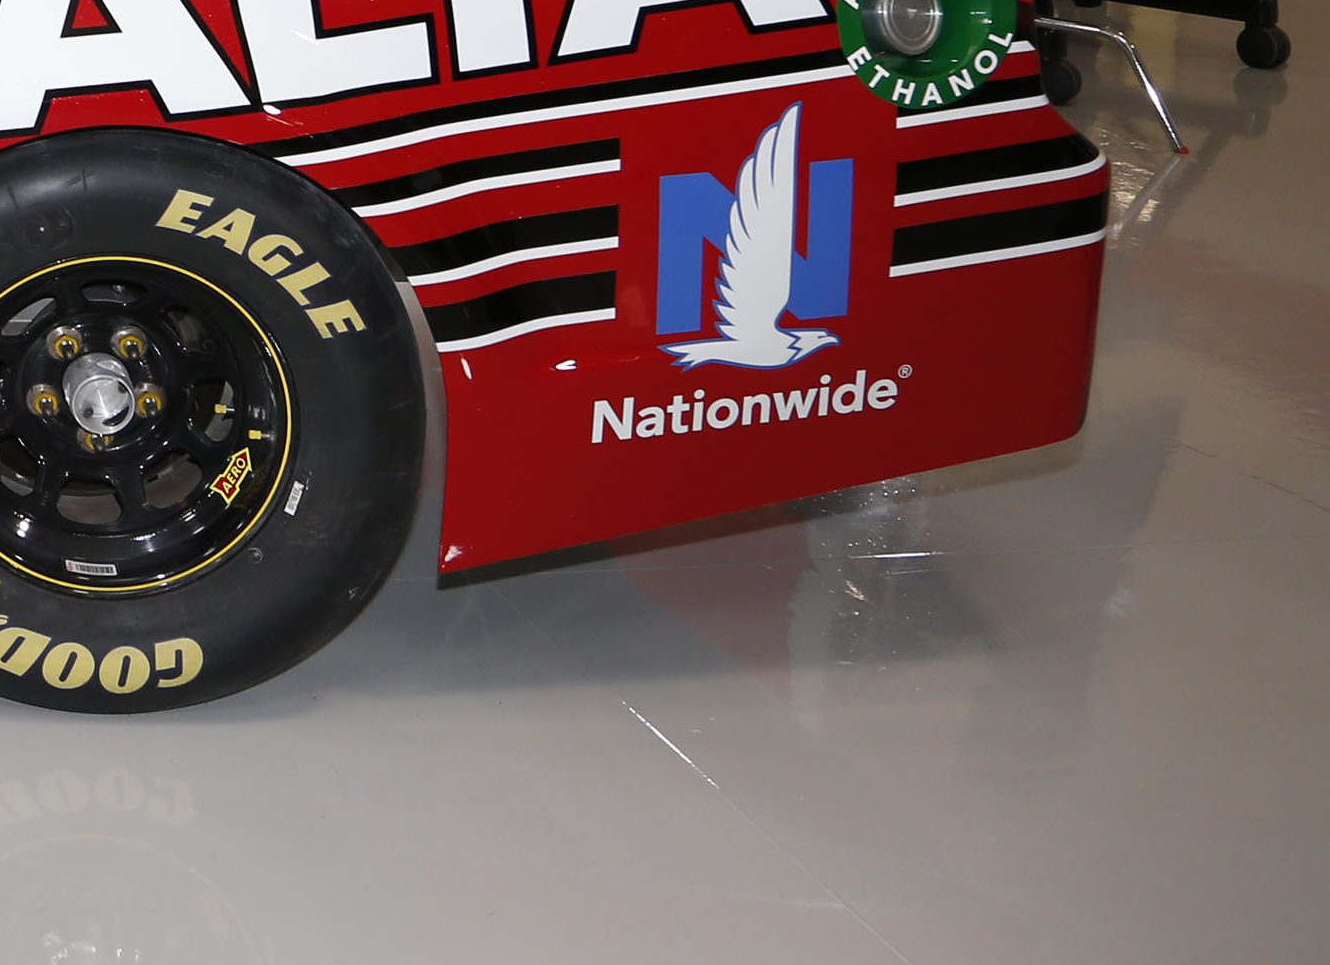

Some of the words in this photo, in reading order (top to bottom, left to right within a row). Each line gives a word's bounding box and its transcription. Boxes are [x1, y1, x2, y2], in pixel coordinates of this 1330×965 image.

[846, 32, 1013, 106] ETHANOL
[155, 189, 367, 339] EAGLE
[221, 458, 246, 495] AERO
